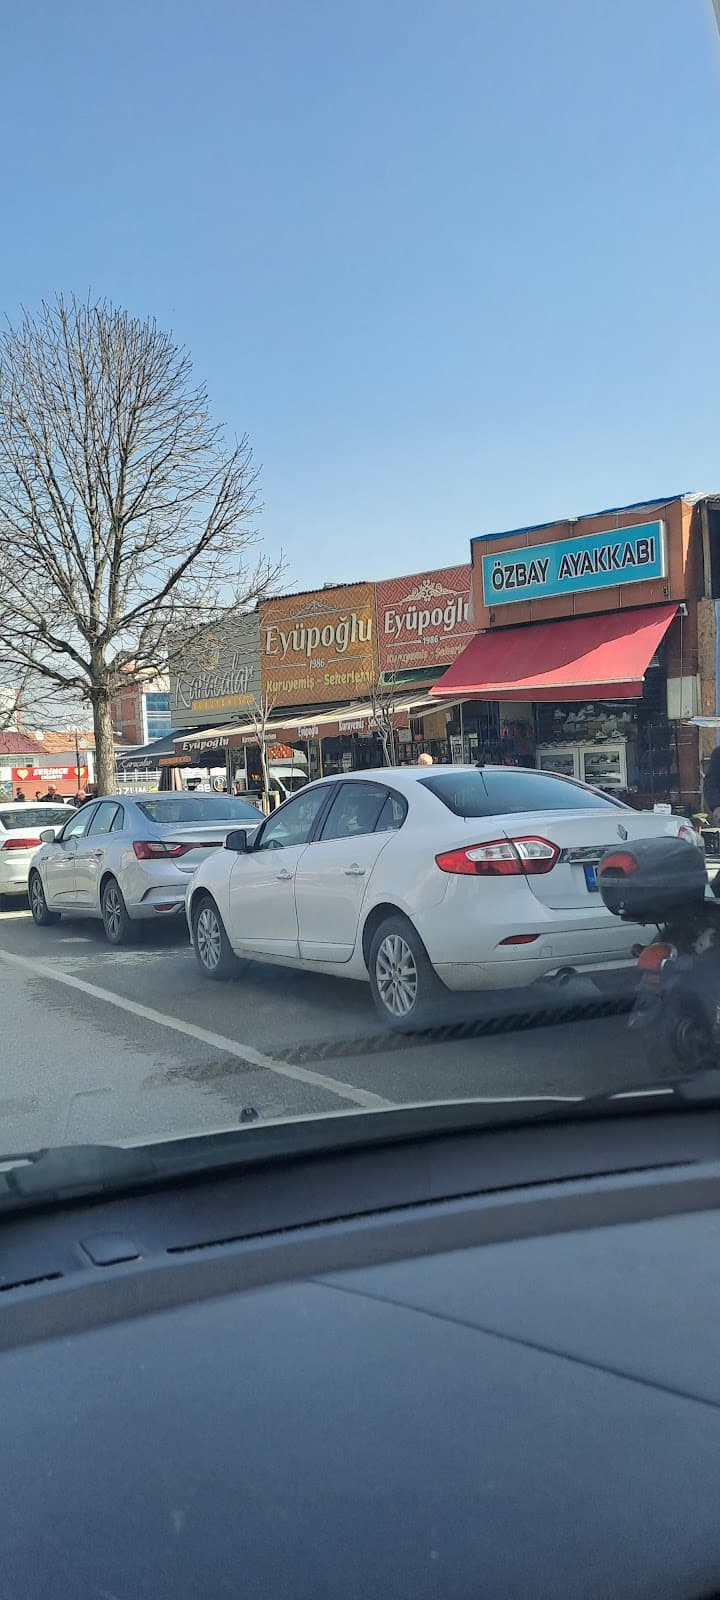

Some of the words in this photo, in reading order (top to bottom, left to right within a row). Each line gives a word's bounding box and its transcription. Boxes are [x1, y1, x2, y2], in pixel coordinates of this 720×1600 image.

[491, 557, 550, 592] ÖZBAY
[557, 536, 656, 580] AYAKKABI
[266, 613, 373, 660] Eyüpoğlu
[310, 658, 325, 669] 1986
[182, 736, 230, 752] Eyüpoğlu
